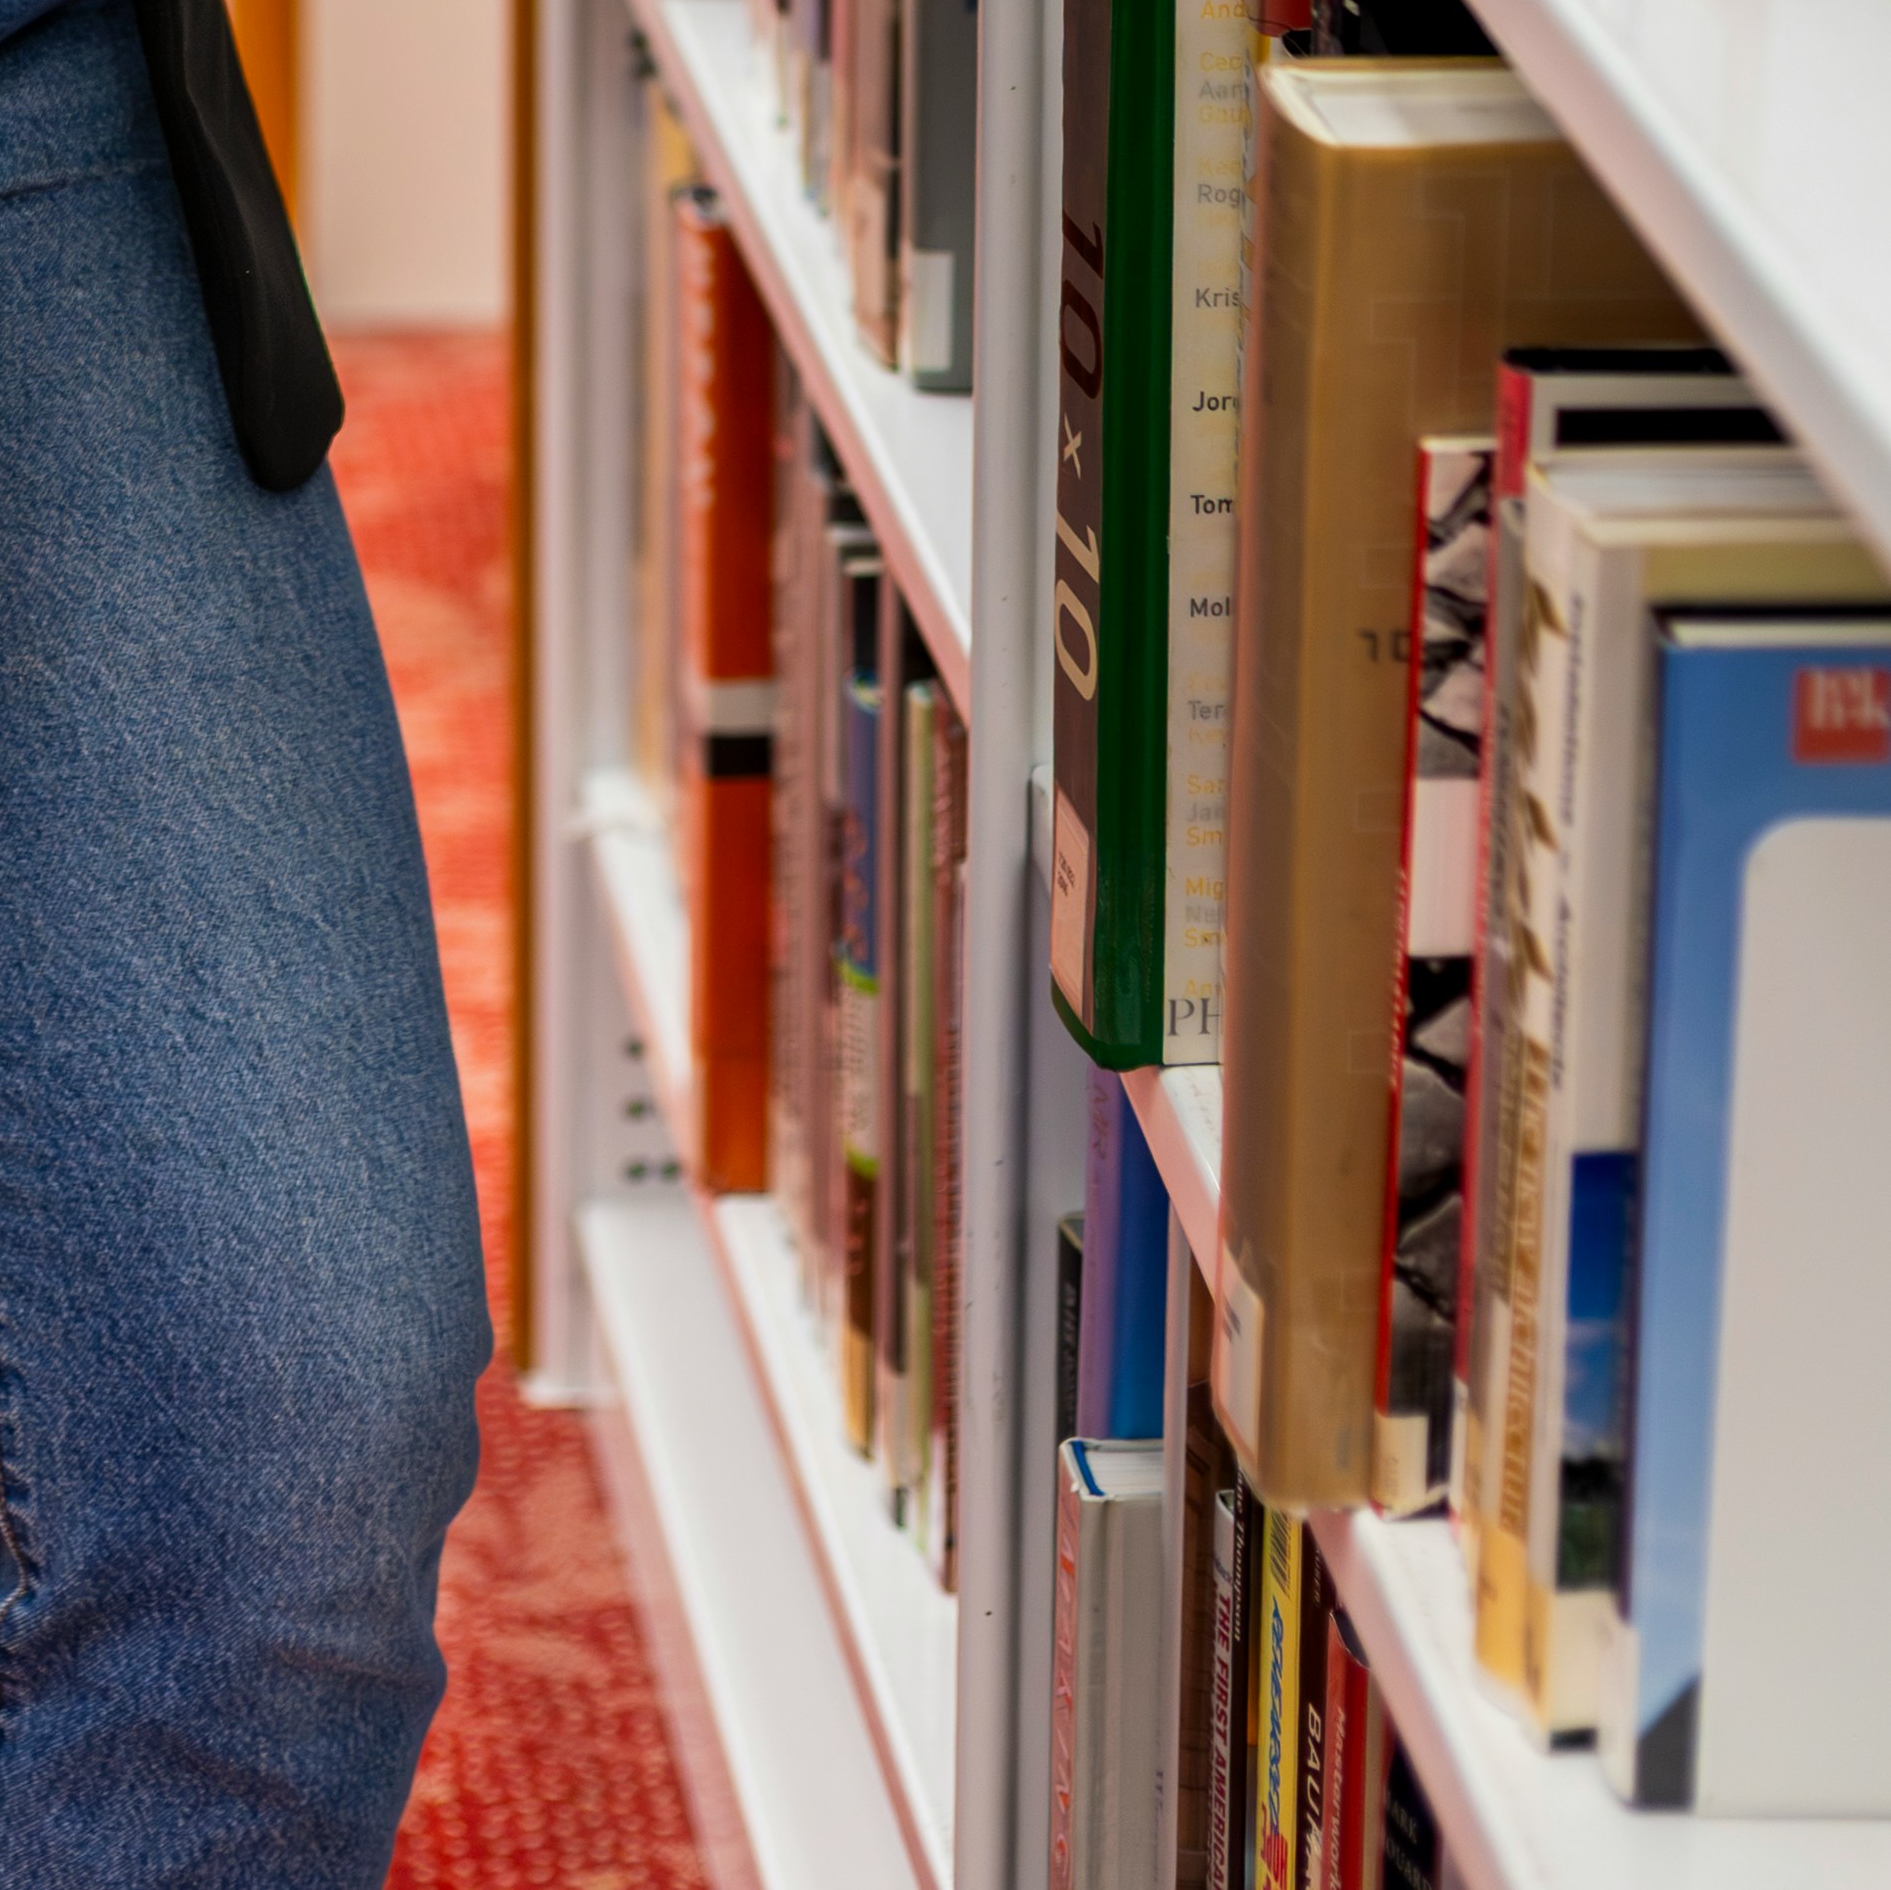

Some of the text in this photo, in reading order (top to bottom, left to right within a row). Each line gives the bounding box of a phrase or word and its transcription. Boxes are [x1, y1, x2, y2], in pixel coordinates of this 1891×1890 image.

[1053, 511, 1101, 701] 10
[1218, 1593, 1232, 1652] THE
[1233, 1520, 1245, 1643] Thompson
[1214, 1655, 1230, 1746] FIRST
